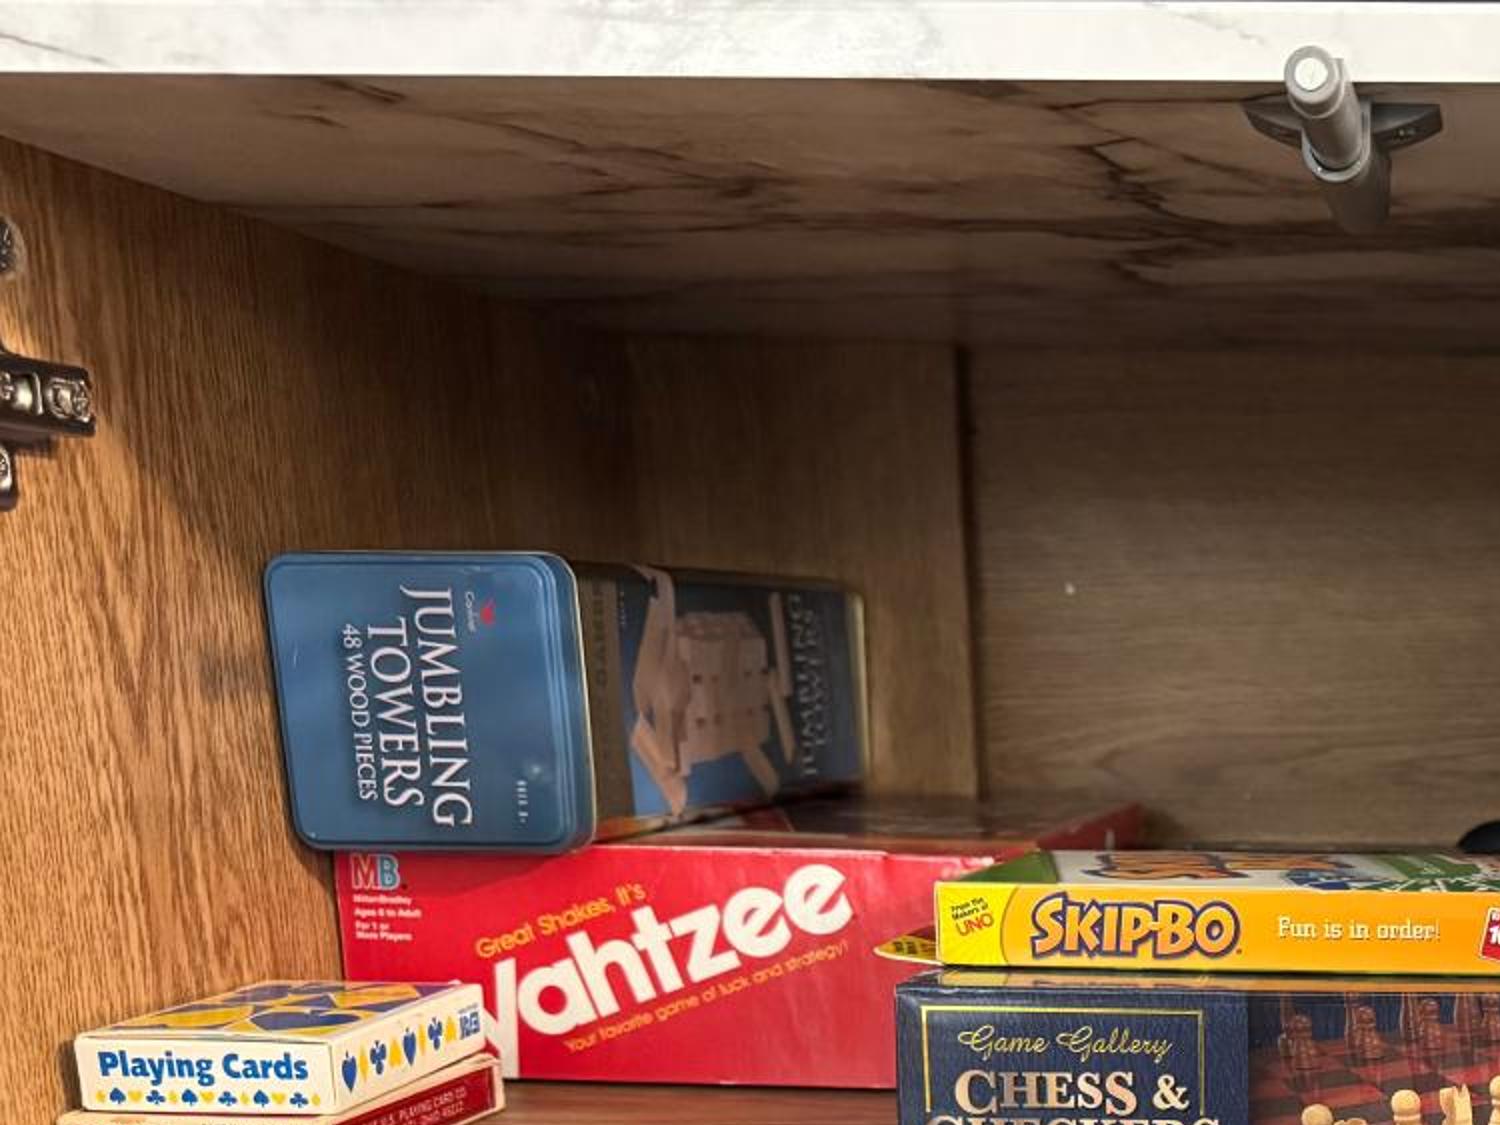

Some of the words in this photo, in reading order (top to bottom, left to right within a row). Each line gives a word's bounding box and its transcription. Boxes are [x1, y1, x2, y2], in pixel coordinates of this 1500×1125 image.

[341, 624, 362, 648] 48
[345, 655, 370, 726] WOOD
[367, 616, 424, 807] TOWERS
[400, 585, 472, 826] JUMBLING
[353, 734, 377, 800] PIECES
[351, 853, 400, 891] MB
[475, 925, 536, 960] Great
[537, 896, 616, 938] Shakes,
[615, 882, 647, 907] It's
[956, 913, 995, 936] UNO
[1278, 915, 1317, 939] Fun
[1323, 916, 1343, 940] is
[1348, 917, 1371, 941] in
[1377, 915, 1441, 941] order!
[563, 1029, 598, 1054] Your
[599, 1010, 653, 1042] favorite
[655, 995, 700, 1024] game
[702, 985, 719, 1003] of
[718, 976, 752, 997] luck
[753, 963, 784, 985] and
[98, 1050, 214, 1085] Playing
[222, 1051, 309, 1082] Cards
[958, 1024, 1049, 1061] Game
[1056, 1025, 1173, 1063] Gallery
[955, 1069, 1138, 1117] CHESS
[1152, 1074, 1190, 1111] &
